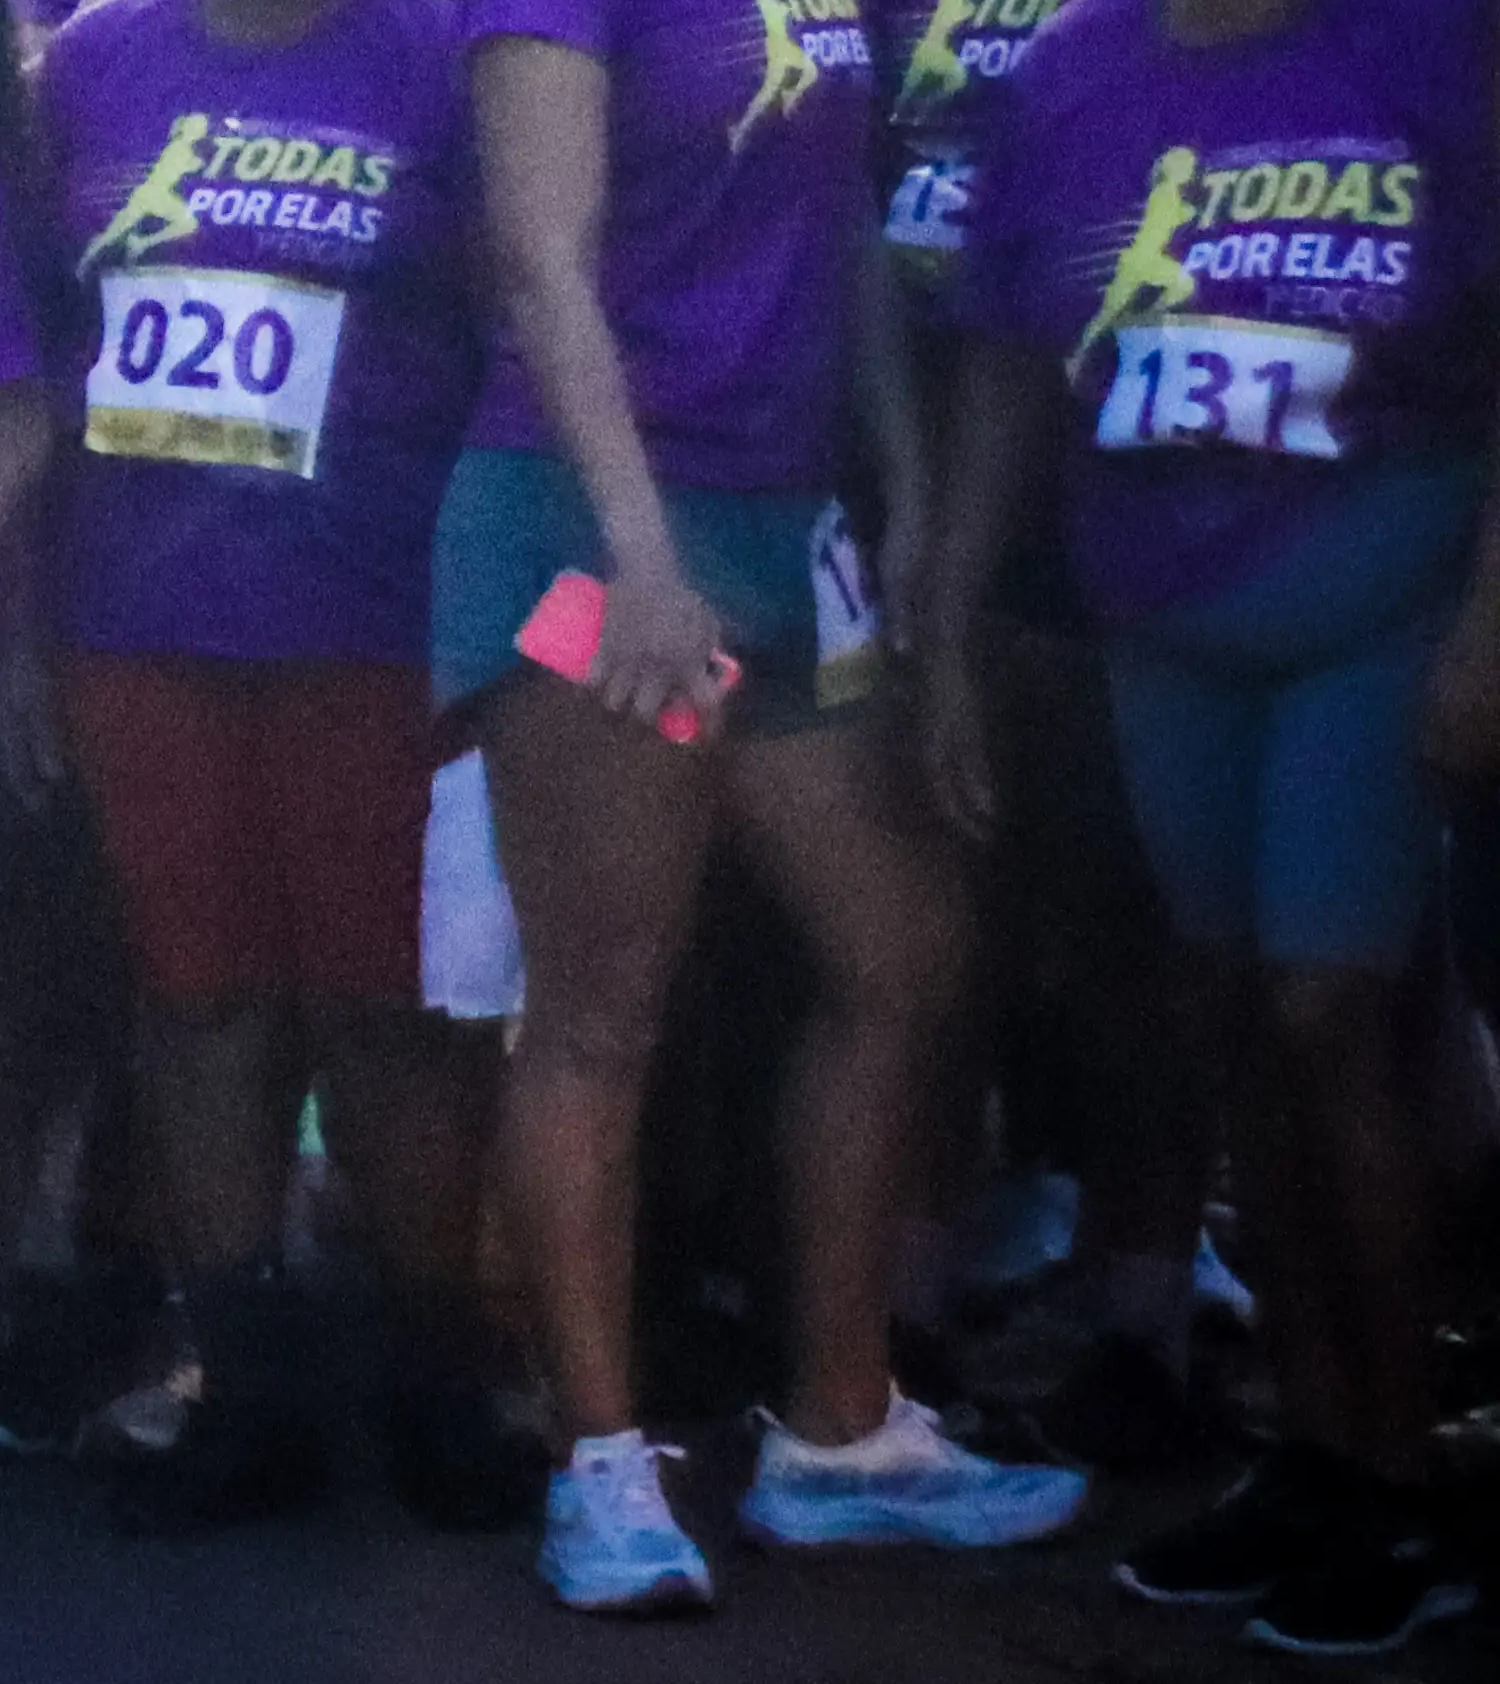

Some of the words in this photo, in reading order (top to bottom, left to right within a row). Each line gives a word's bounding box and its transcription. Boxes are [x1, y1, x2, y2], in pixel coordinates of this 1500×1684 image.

[202, 137, 394, 197] TODAS
[1200, 161, 1418, 227] TODAS
[189, 188, 273, 225] POR
[274, 192, 383, 242] ELAS
[1183, 232, 1281, 280] POR
[1281, 232, 1412, 284] ELAS
[116, 299, 295, 396] 020
[1139, 350, 1294, 449] 131
